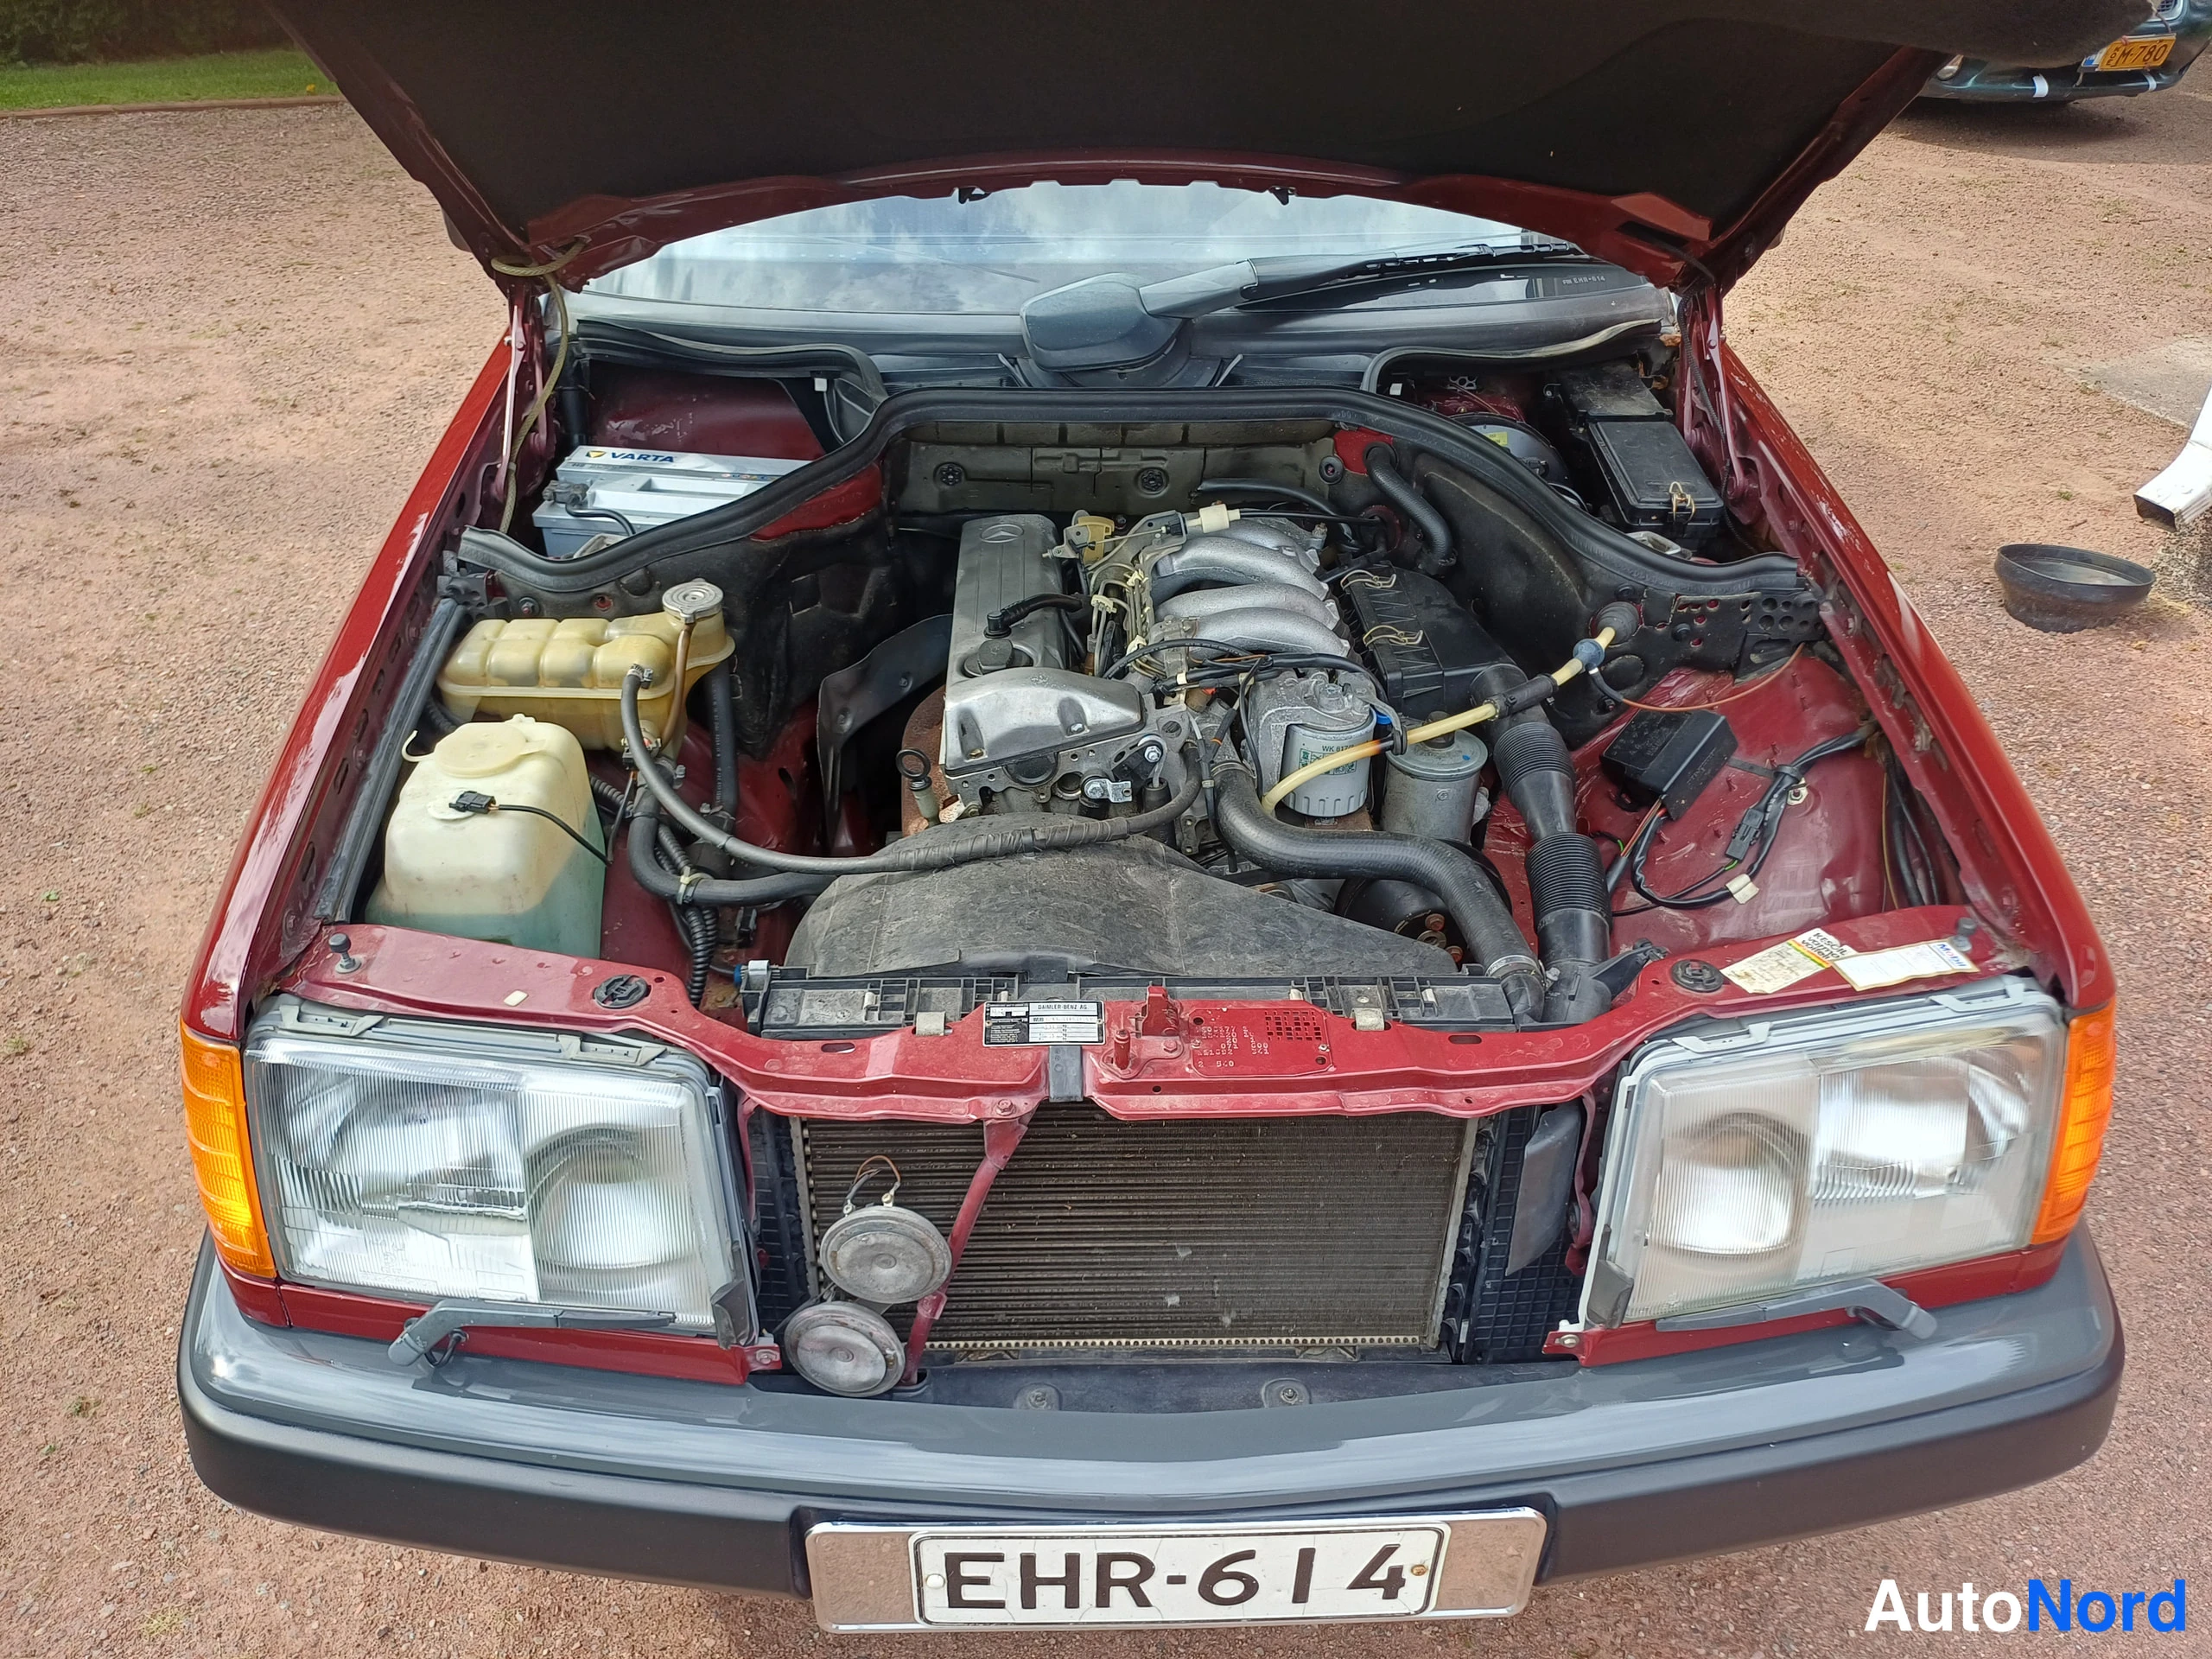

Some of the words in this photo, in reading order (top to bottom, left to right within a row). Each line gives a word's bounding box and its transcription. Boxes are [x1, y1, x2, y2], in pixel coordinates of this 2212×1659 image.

[611, 452, 674, 463] VARTA
[1936, 944, 1967, 967] Mobil
[944, 1543, 1407, 1609] EHR-614
